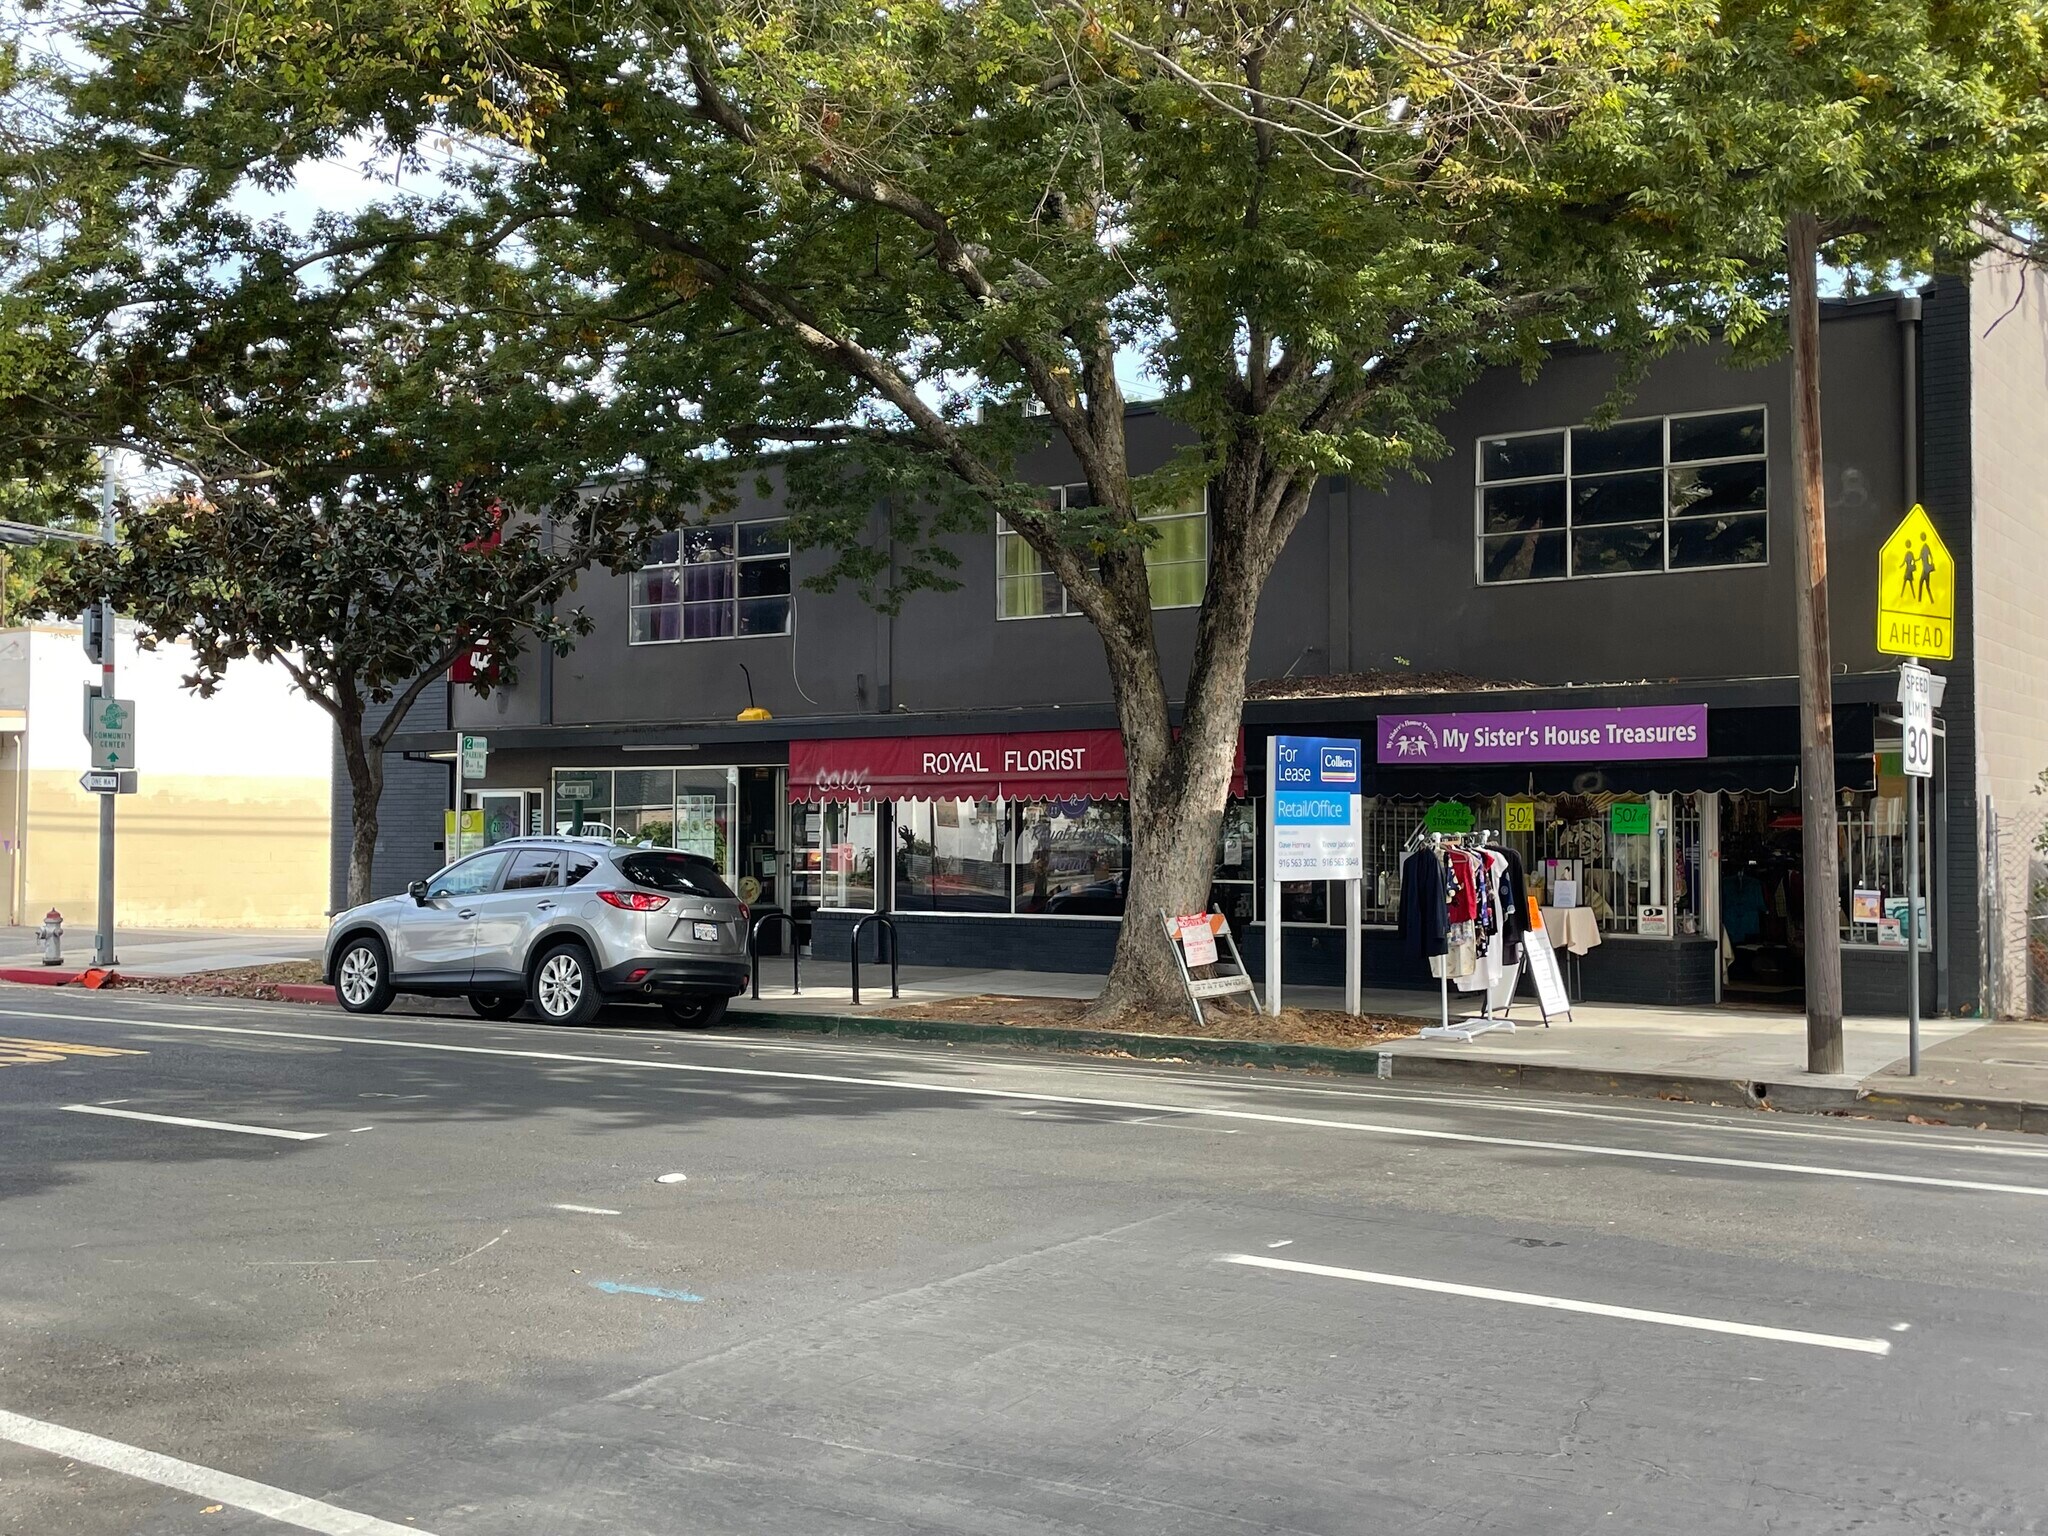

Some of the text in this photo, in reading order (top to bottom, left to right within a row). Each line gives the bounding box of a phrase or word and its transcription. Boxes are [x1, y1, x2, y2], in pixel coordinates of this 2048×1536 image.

[1889, 622, 1943, 648] AHEAD
[1906, 674, 1928, 694] SPEED
[1908, 702, 1927, 718] LIMIT
[94, 732, 132, 740] COMMUNITY
[466, 738, 473, 749] 2
[1443, 724, 1697, 752] My Sister's House Treasures
[1279, 745, 1298, 762] For
[1907, 726, 1929, 765] 30
[923, 748, 1085, 774] ROYAL FLORIST
[1325, 755, 1352, 767] Colliers
[91, 777, 102, 785] ONE
[1279, 764, 1311, 782] Lease
[1278, 800, 1342, 817] Retail/Office
[1508, 807, 1531, 823] 50%
[1615, 808, 1638, 824] 50%
[1279, 859, 1290, 868] 916
